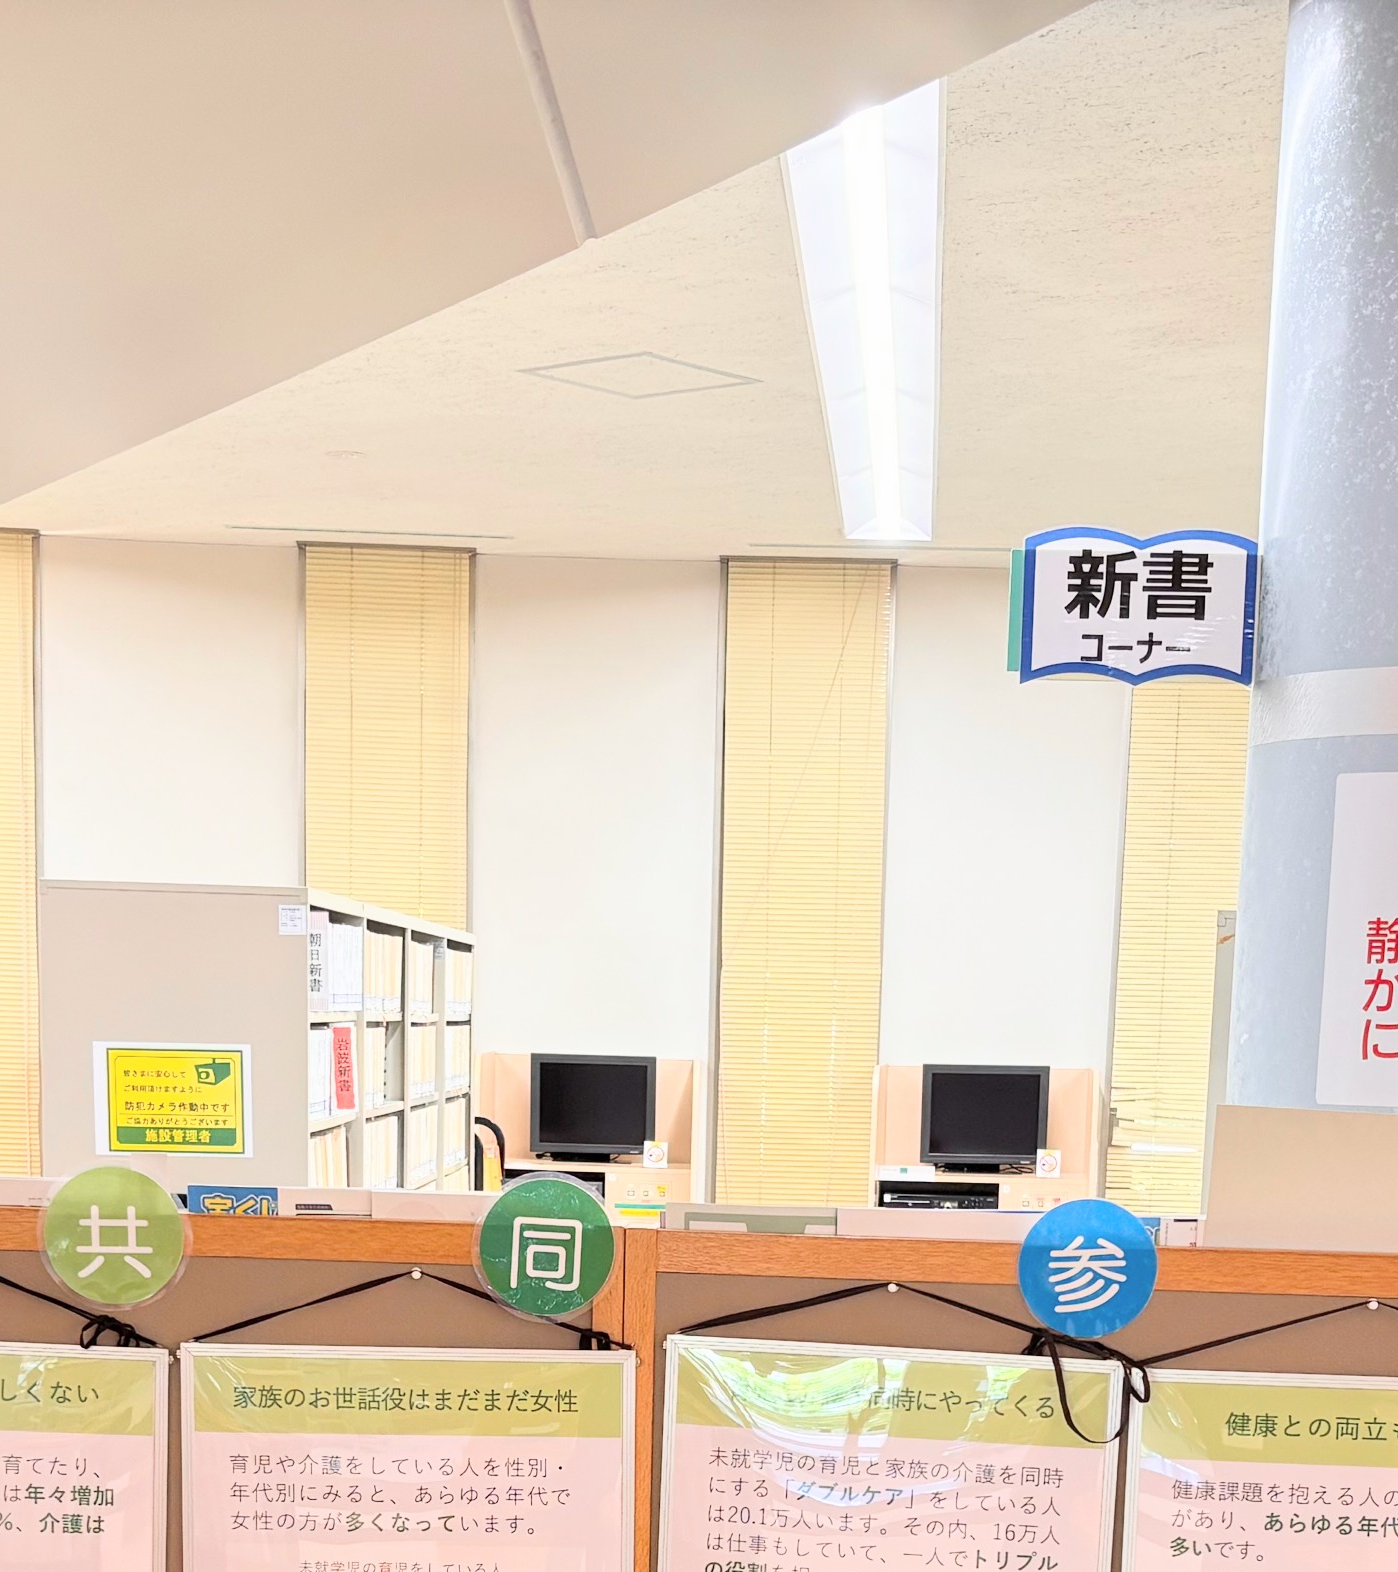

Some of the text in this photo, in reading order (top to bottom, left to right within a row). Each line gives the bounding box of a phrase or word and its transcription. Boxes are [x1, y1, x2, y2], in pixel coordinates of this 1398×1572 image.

[1065, 549, 1214, 621] 新書
[1080, 632, 1191, 664] コーナー
[310, 933, 323, 993] 朝日新書
[336, 1038, 351, 1092] 岩波新書
[125, 1101, 230, 1113] 防犯カメラ作動中です
[145, 1129, 211, 1143] 施設管理者
[77, 1204, 153, 1279] 共
[510, 1216, 582, 1292] 同
[1048, 1236, 1127, 1313] 参
[232, 1385, 579, 1413] 家族のお世話役はまだまだ女性
[708, 1448, 1064, 1487] 未就学児の育児と家族の介護を同時
[229, 1482, 570, 1506] 年代別にみると、あらゆる年代で
[230, 1510, 536, 1535] 女性の方が多くなっています。
[707, 1533, 1058, 1572] は仕事もしていて、一人でトリプル
[1170, 1536, 1265, 1563] 多いです。
